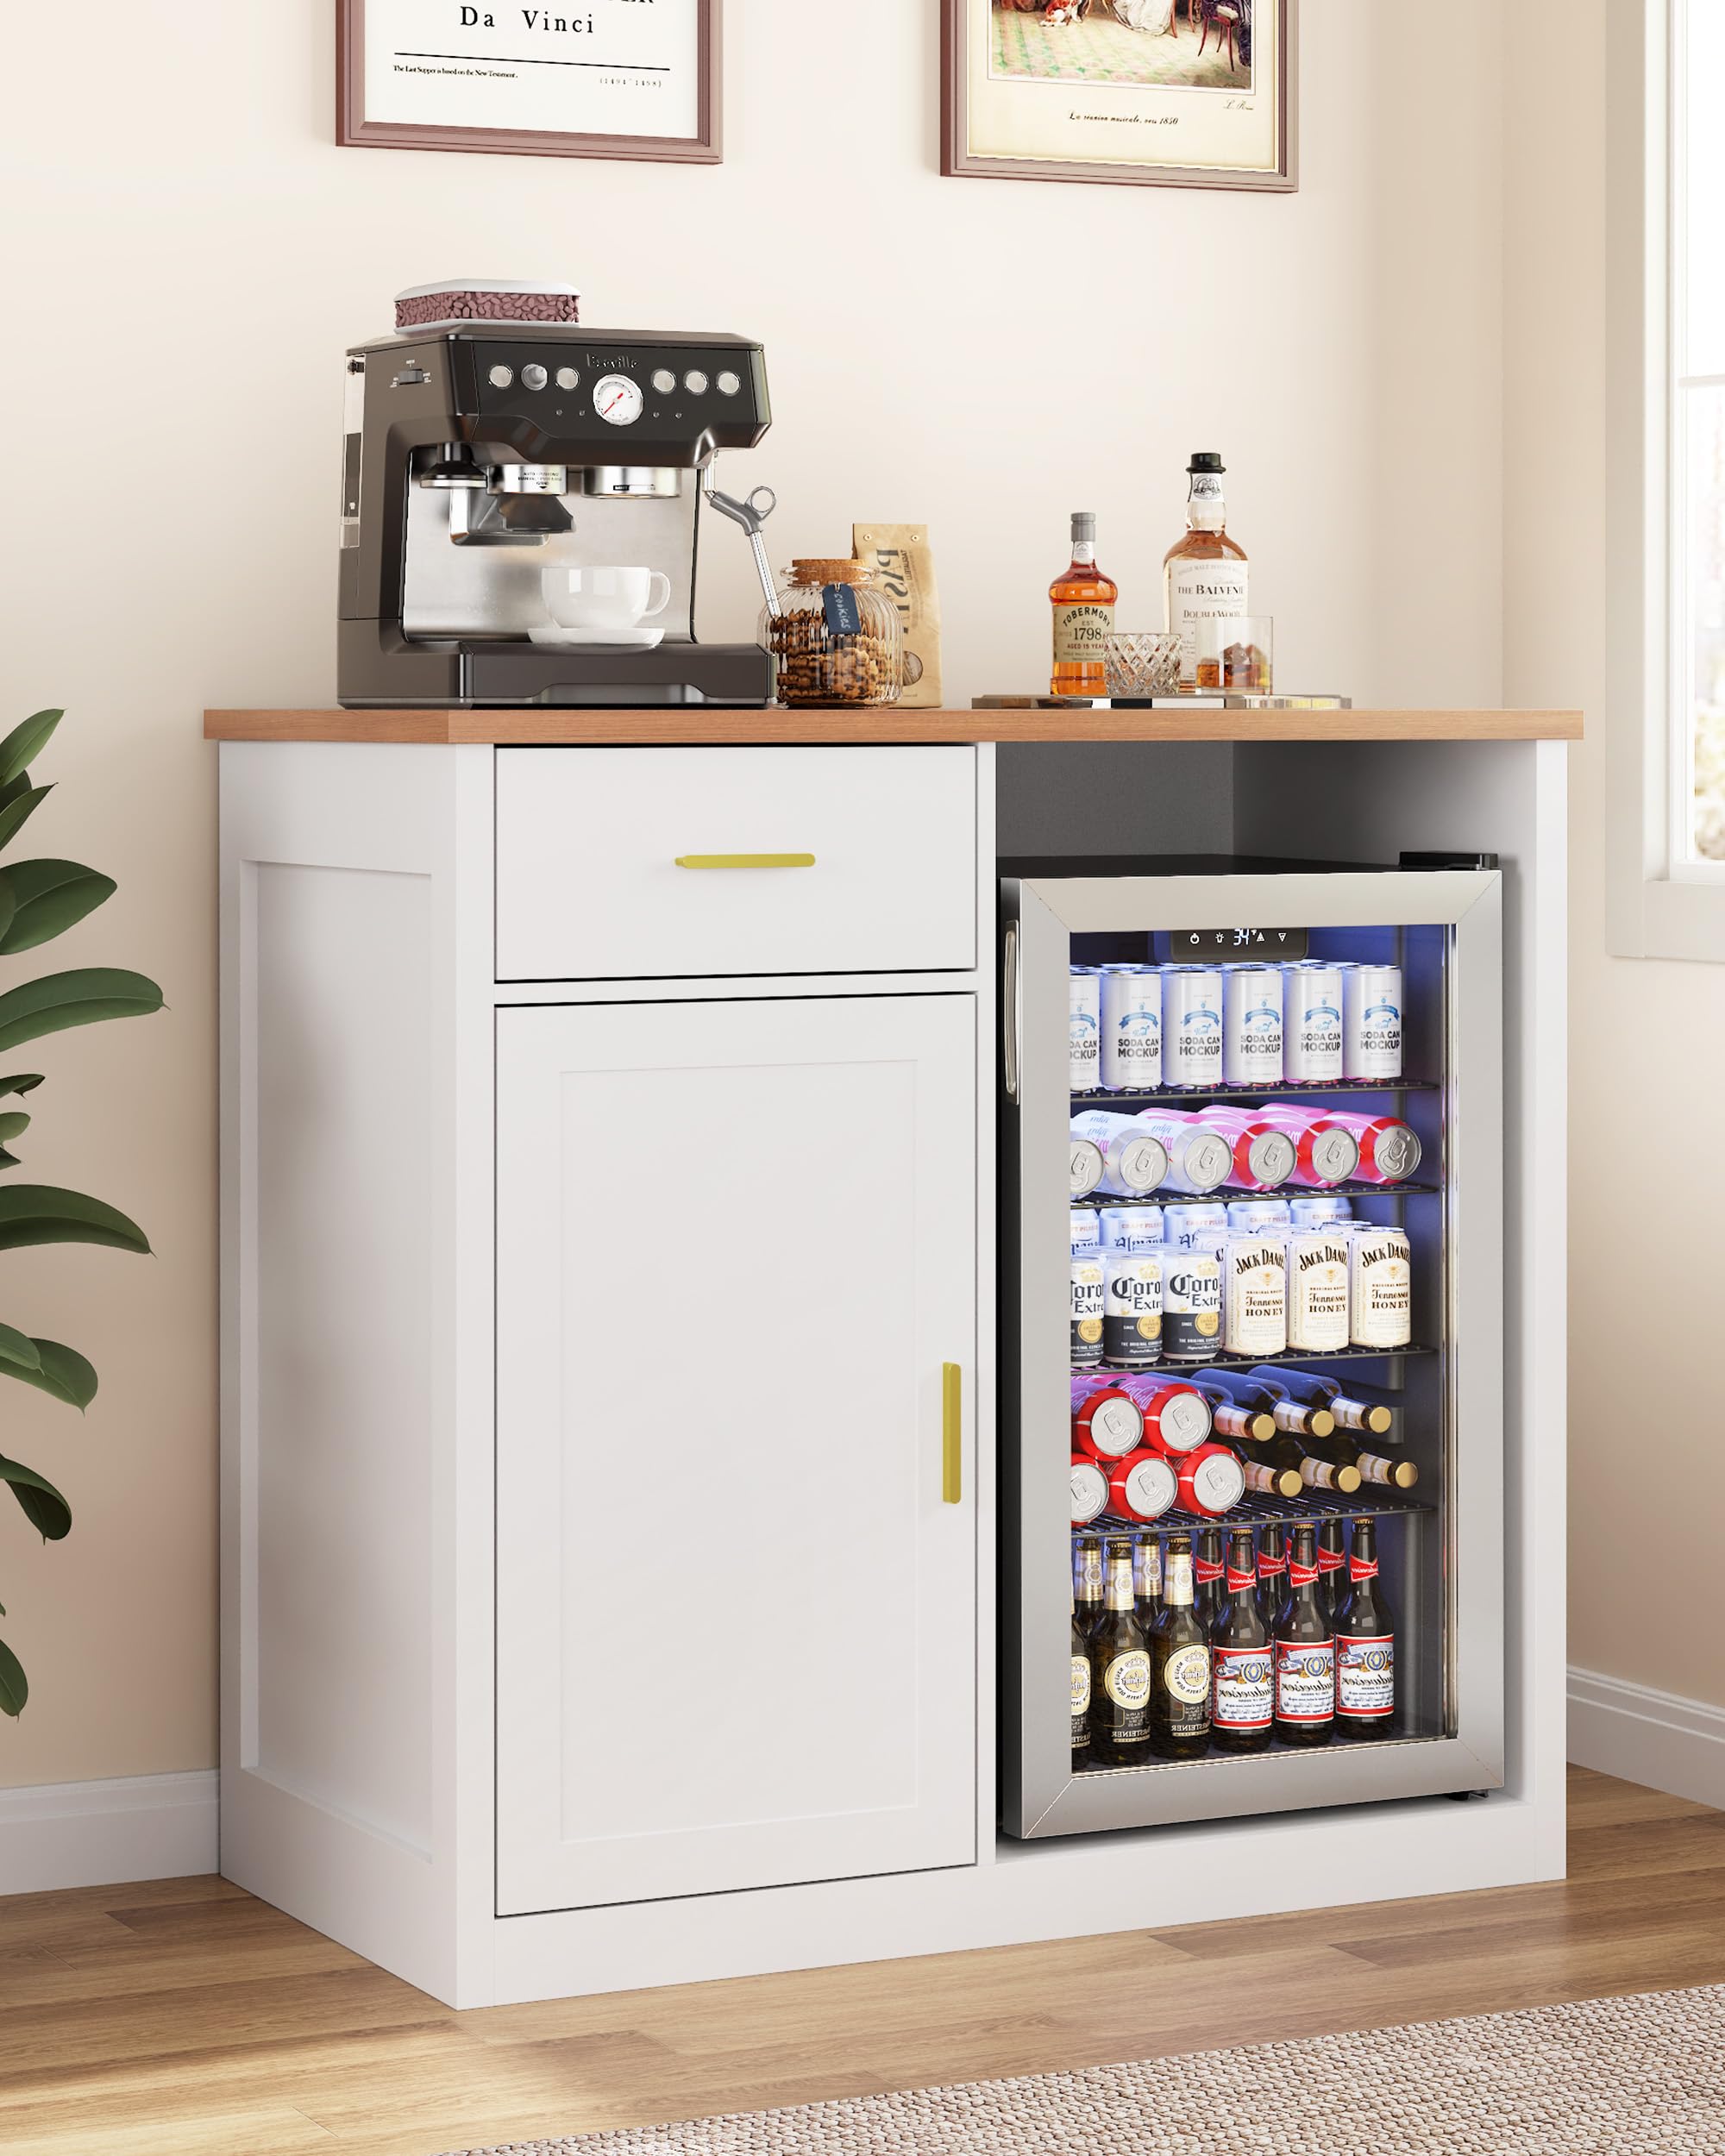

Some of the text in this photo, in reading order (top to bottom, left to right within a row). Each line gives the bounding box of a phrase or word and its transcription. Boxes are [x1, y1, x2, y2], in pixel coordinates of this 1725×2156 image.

[461, 6, 593, 34] Da Vinci
[1177, 586, 1194, 594] THE
[1063, 606, 1111, 627] TOBERMORY
[1074, 628, 1102, 640] 1798
[1180, 1036, 1220, 1045] SODA CAN
[1268, 1034, 1281, 1043] CAN
[1328, 1032, 1340, 1041] CAN
[1070, 1040, 1097, 1049] DA CAN
[1118, 1038, 1144, 1047] SODA
[1301, 1042, 1341, 1052] MOCKUP
[1360, 1040, 1401, 1050] MOCKUP
[1118, 1048, 1159, 1058] MOCKUP
[1180, 1045, 1220, 1056] MOCKUP
[1240, 1044, 1281, 1054] MOCKUP
[1070, 1049, 1097, 1060] CKUP
[1300, 1250, 1324, 1271] JACK
[1362, 1247, 1387, 1268] JACK
[1236, 1253, 1261, 1275] JACK
[1309, 1304, 1346, 1313] HONEY
[1372, 1300, 1408, 1309] HONEY
[1245, 1307, 1283, 1316] HONEY
